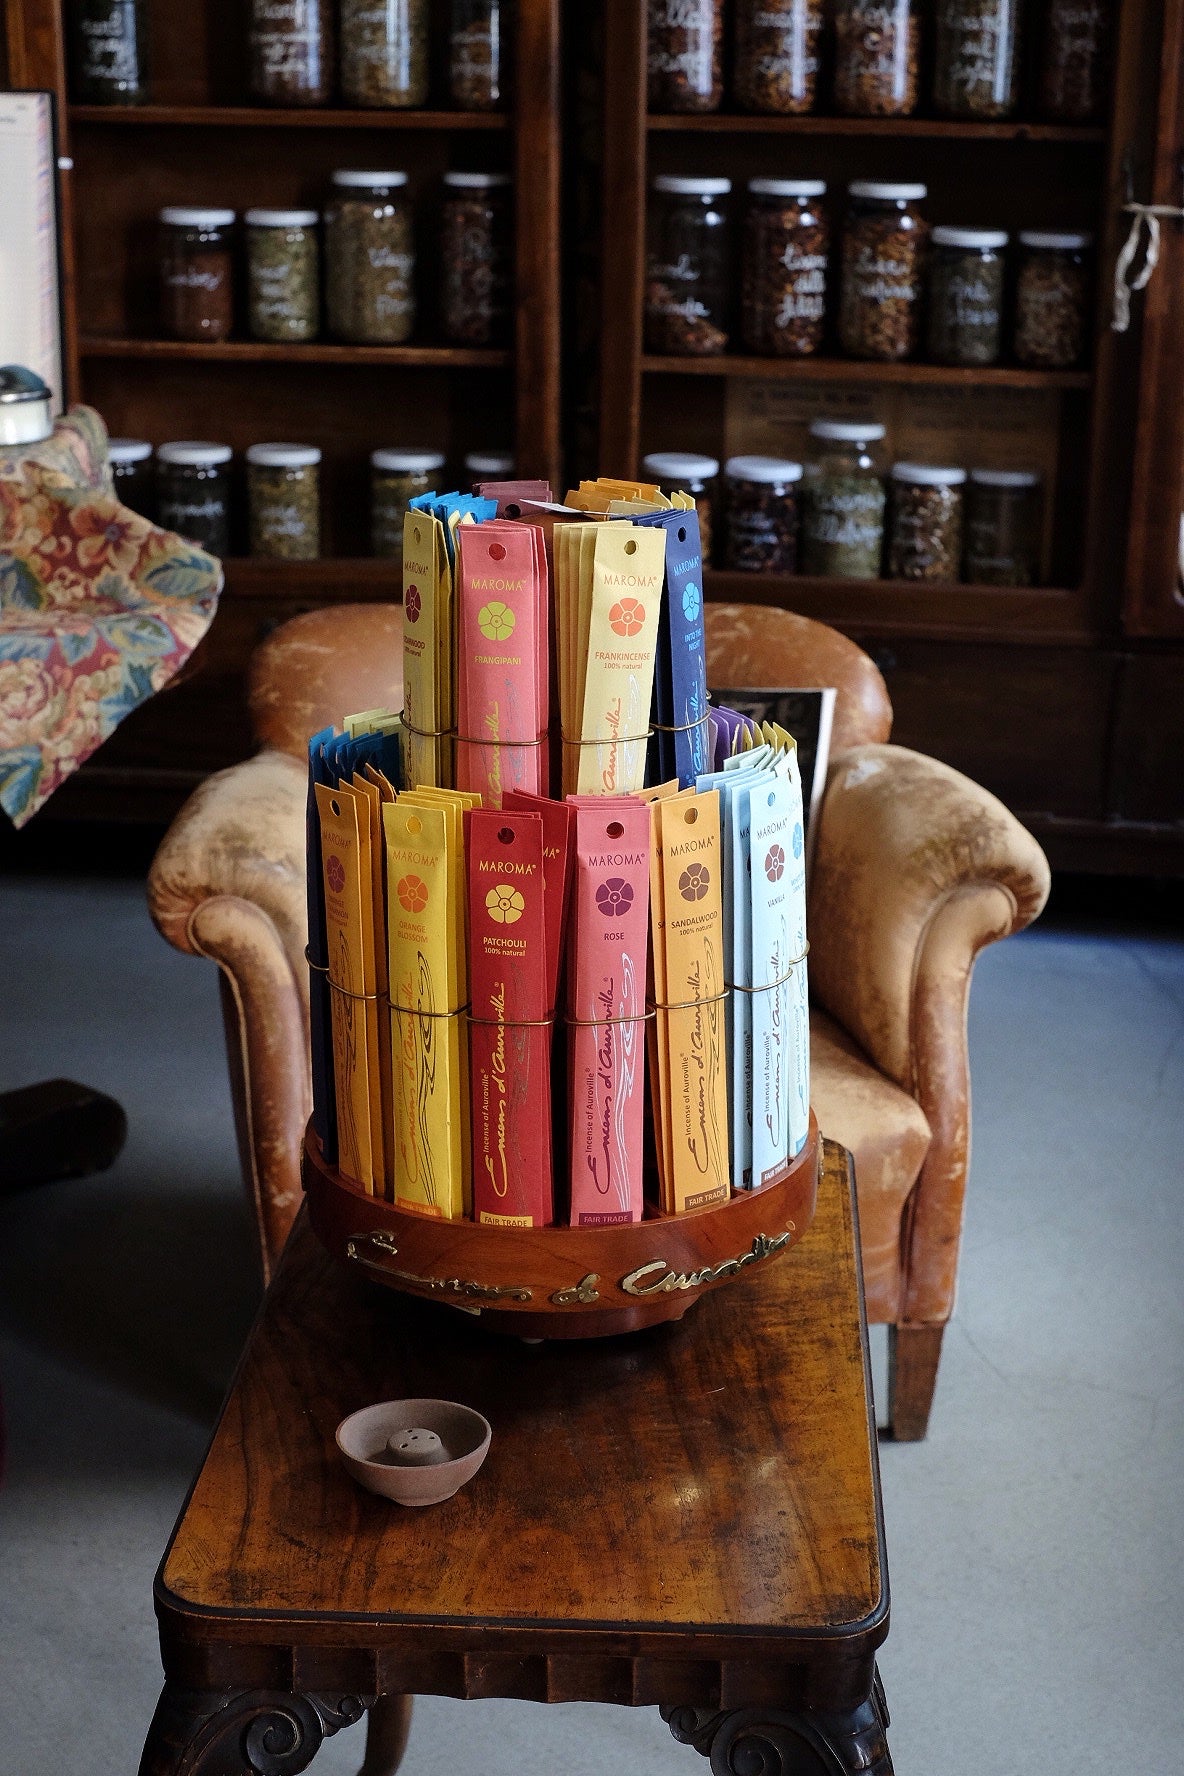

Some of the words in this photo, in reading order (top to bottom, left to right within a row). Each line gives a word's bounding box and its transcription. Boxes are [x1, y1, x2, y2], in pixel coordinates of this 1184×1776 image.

[474, 655, 522, 666] FRANGIPANI
[595, 651, 651, 662] FRANKINCENSE
[603, 661, 621, 670] 100%
[622, 661, 643, 670] natural
[671, 911, 719, 930] SANDALWOOD
[399, 920, 427, 934] ORANGE
[679, 925, 695, 936] 100%
[695, 923, 714, 934] natural
[397, 930, 428, 944] BLOSSOM
[483, 936, 527, 948] PATCHOULI
[603, 932, 625, 941] ROSE
[484, 947, 501, 956] 100%
[502, 948, 526, 957] natural
[681, 1057, 690, 1093] Auroville
[764, 1071, 770, 1080] of
[481, 1074, 489, 1109] Auroville
[585, 1072, 594, 1109] Auroville
[683, 1095, 690, 1103] of
[482, 1111, 489, 1121] of
[585, 1111, 593, 1120] of
[586, 1122, 594, 1153] Incense
[688, 1196, 703, 1207] FAIR
[703, 1188, 725, 1203] TRADE
[484, 1215, 500, 1225] FAIR
[502, 1218, 528, 1227] TRADE
[583, 1215, 601, 1224] FAIR
[602, 1214, 629, 1223] TRADE
